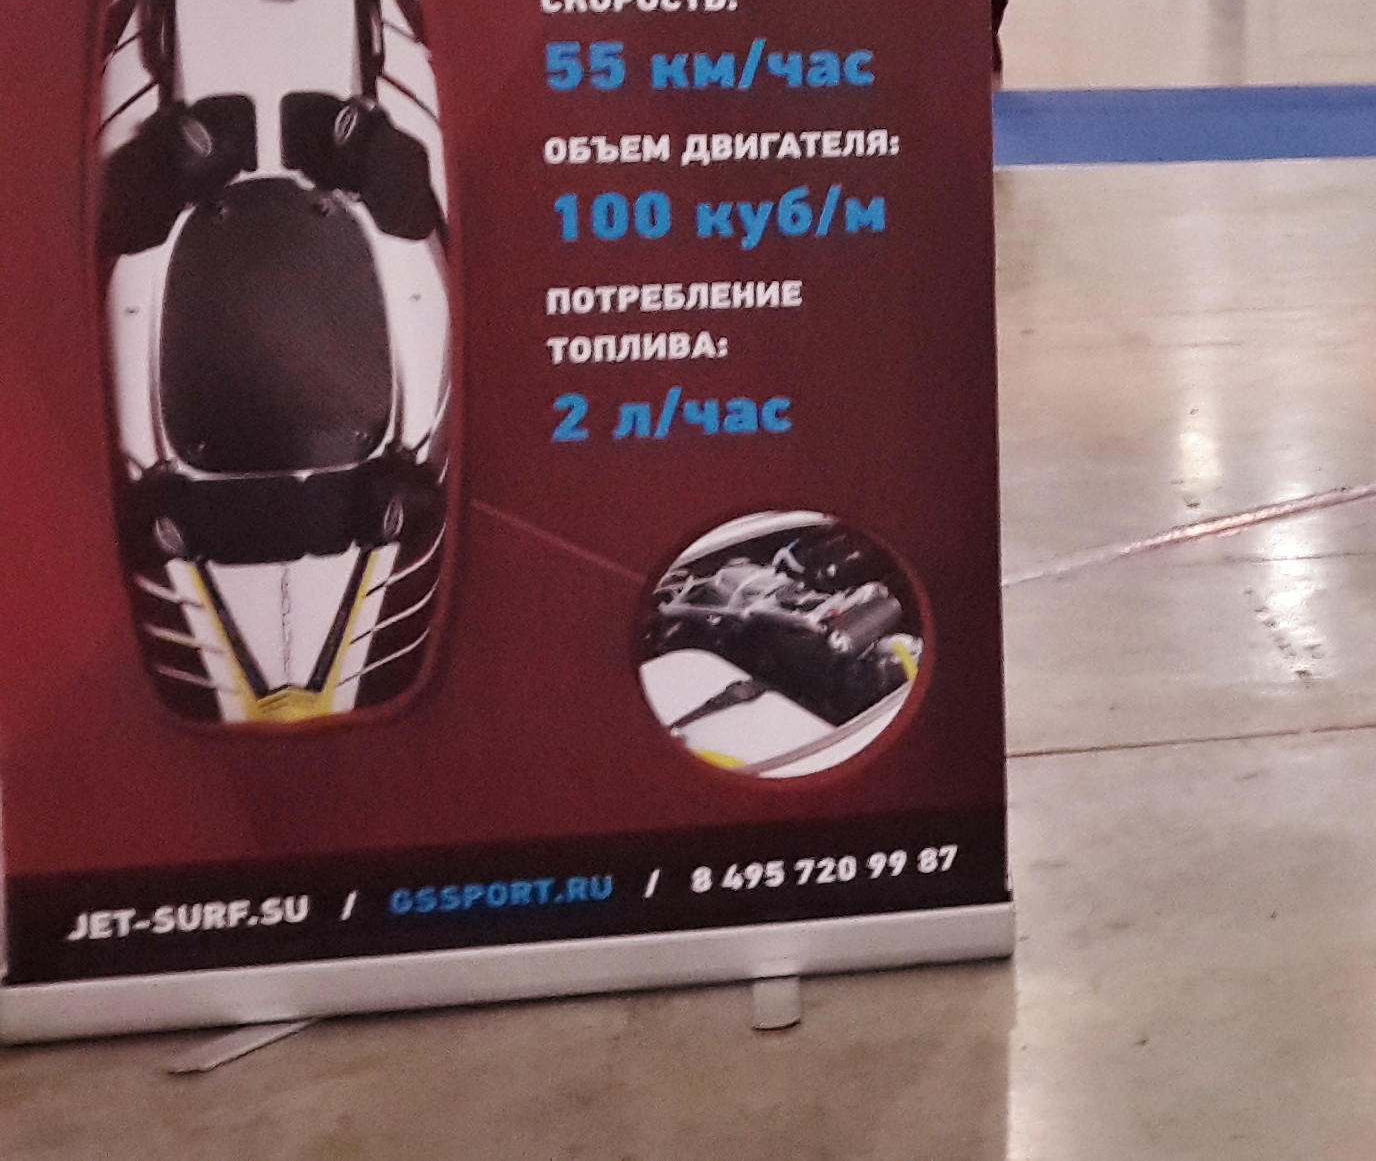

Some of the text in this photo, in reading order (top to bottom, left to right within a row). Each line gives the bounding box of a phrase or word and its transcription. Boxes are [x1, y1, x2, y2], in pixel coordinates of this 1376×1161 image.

[545, 38, 874, 92] 55 км/час
[545, 129, 899, 165] ОБЪЕМ ДВИГАТЕЛЯ:
[553, 185, 887, 251] 100 куб/м
[548, 281, 802, 314] ПОТРЕБЛЕНИЕ
[547, 332, 727, 363] ТОПЛИВА:
[552, 386, 793, 443] 2 л/час
[66, 897, 309, 941] JET-SURF.SU
[390, 877, 613, 914] GSSPORT.RU
[693, 867, 711, 892] 8
[723, 861, 784, 889] 495
[797, 857, 856, 884] 720
[869, 851, 906, 877] 99
[920, 846, 957, 872] 87
